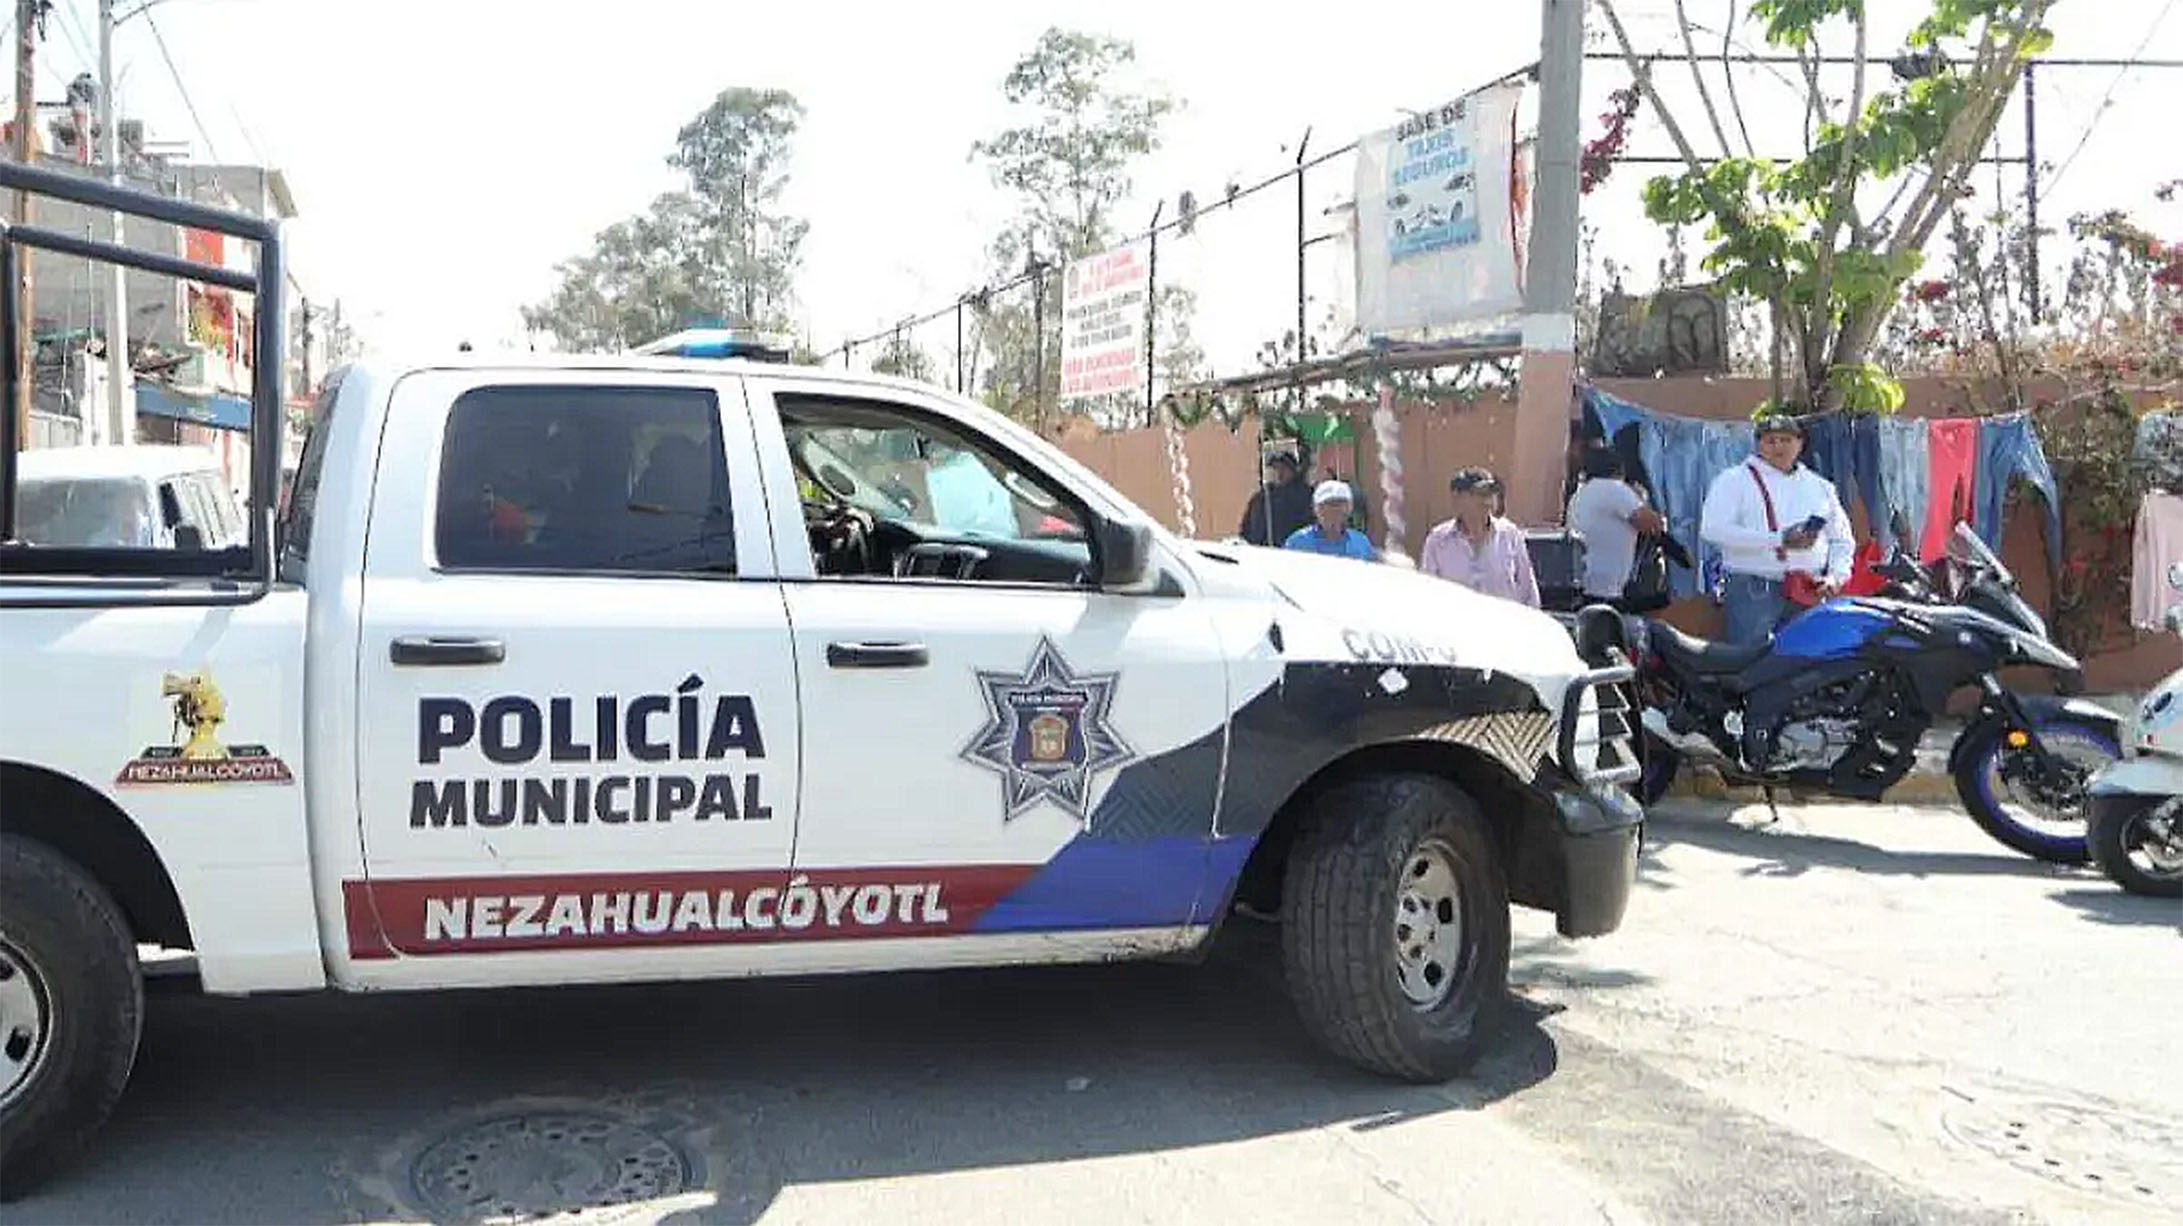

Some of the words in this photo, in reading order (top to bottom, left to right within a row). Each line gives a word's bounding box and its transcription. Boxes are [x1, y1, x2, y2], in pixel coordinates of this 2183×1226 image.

[418, 673, 765, 764] POLICÍA
[410, 774, 773, 829] MUNICIPAL
[424, 875, 950, 941] NEZAHUALCÓYOTL
